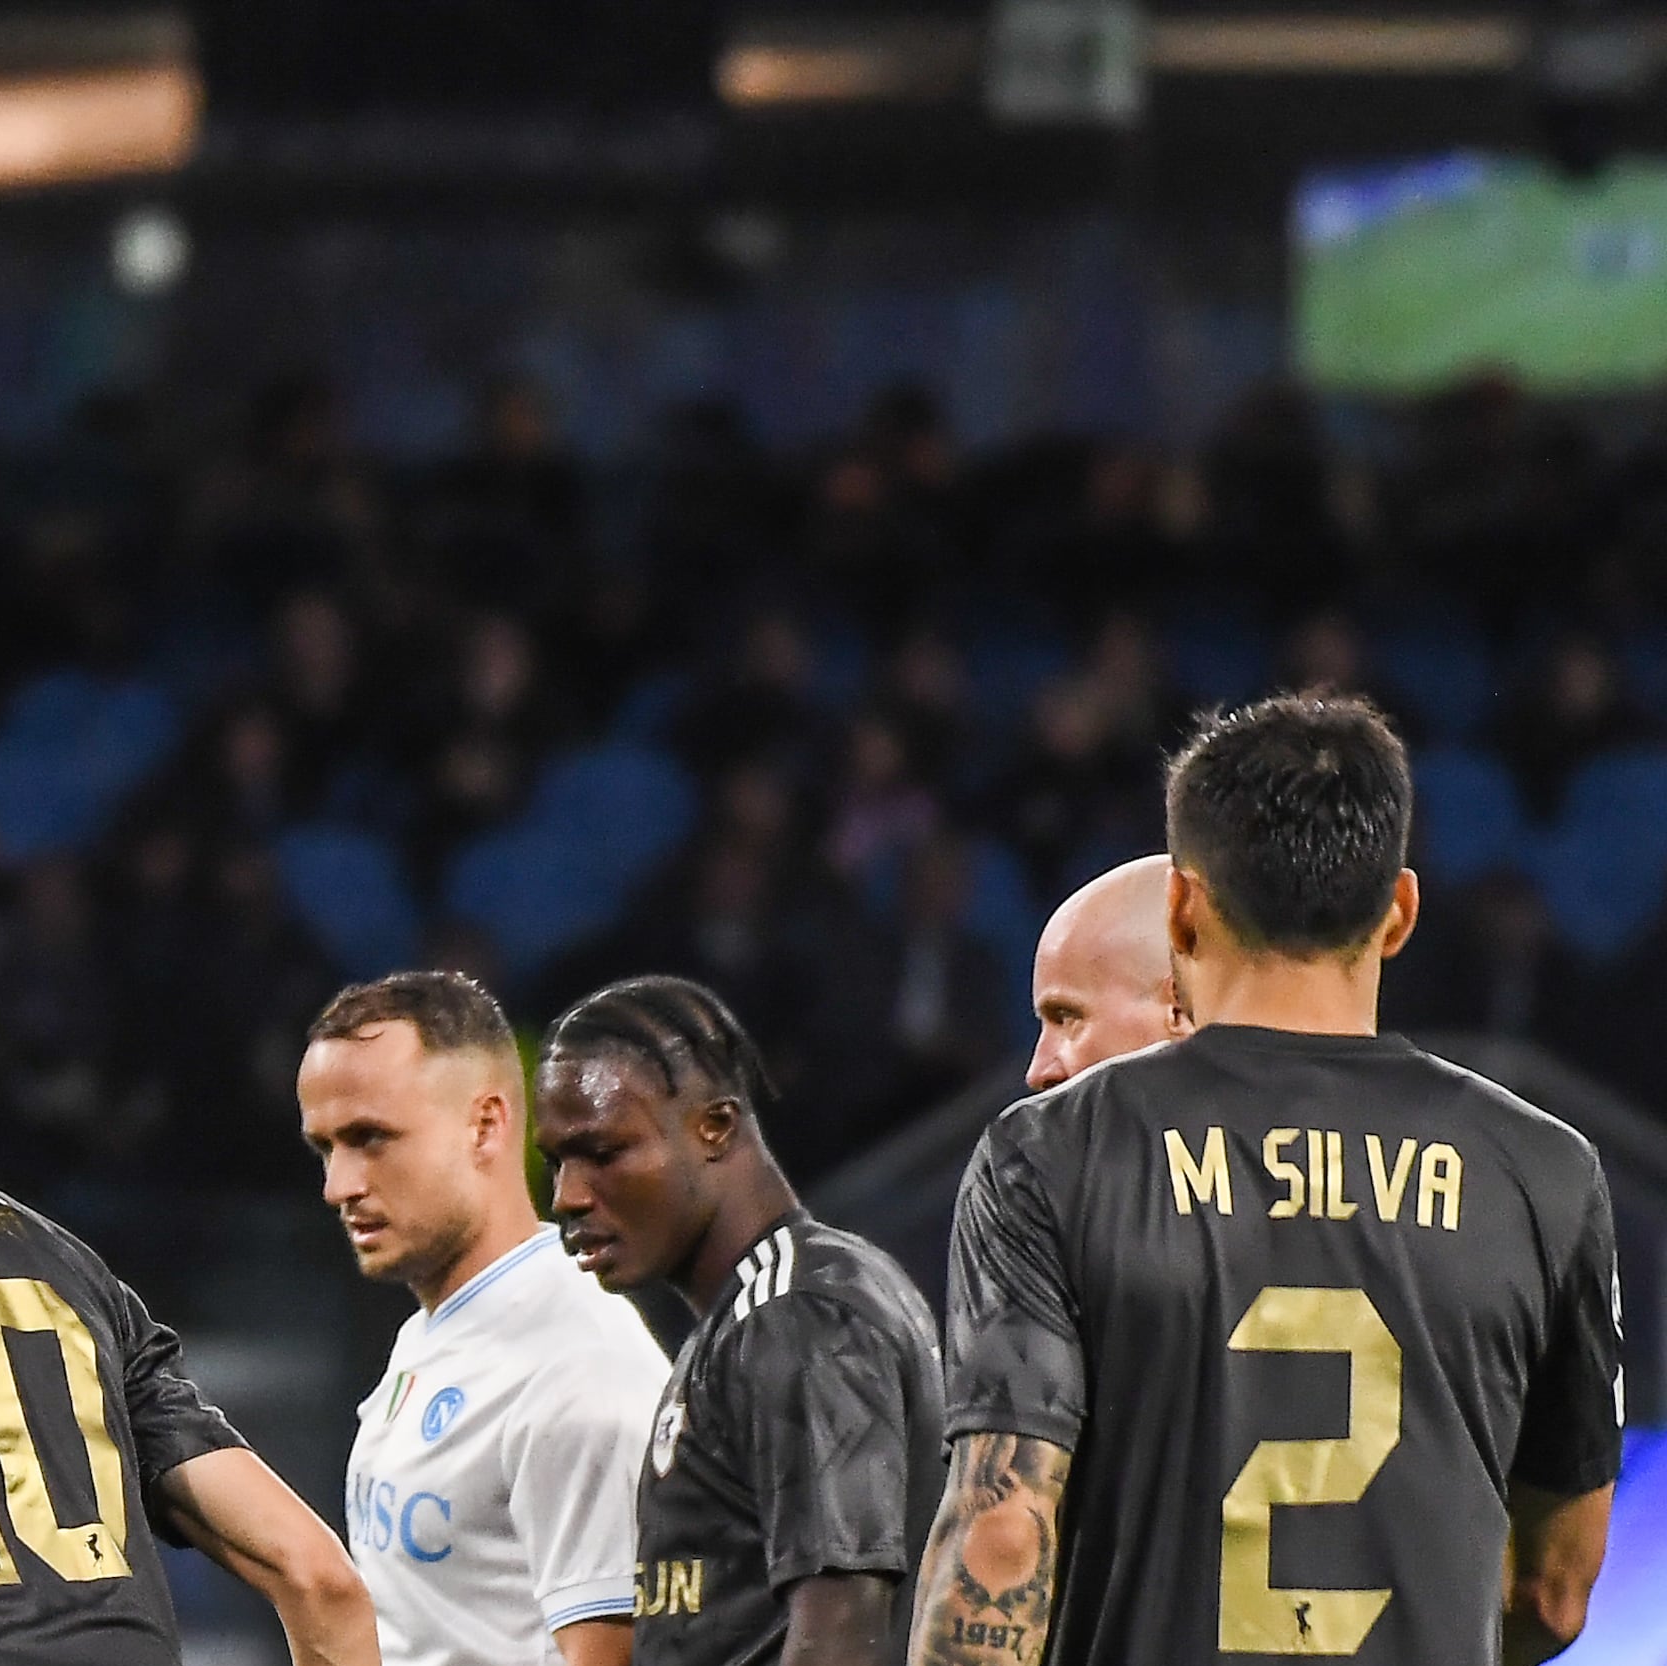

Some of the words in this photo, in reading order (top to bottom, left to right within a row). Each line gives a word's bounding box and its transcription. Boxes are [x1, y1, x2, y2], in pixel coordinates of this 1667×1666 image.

[1163, 1126, 1233, 1217] M
[1263, 1126, 1464, 1232] SILVA
[1218, 1286, 1403, 1656] 2
